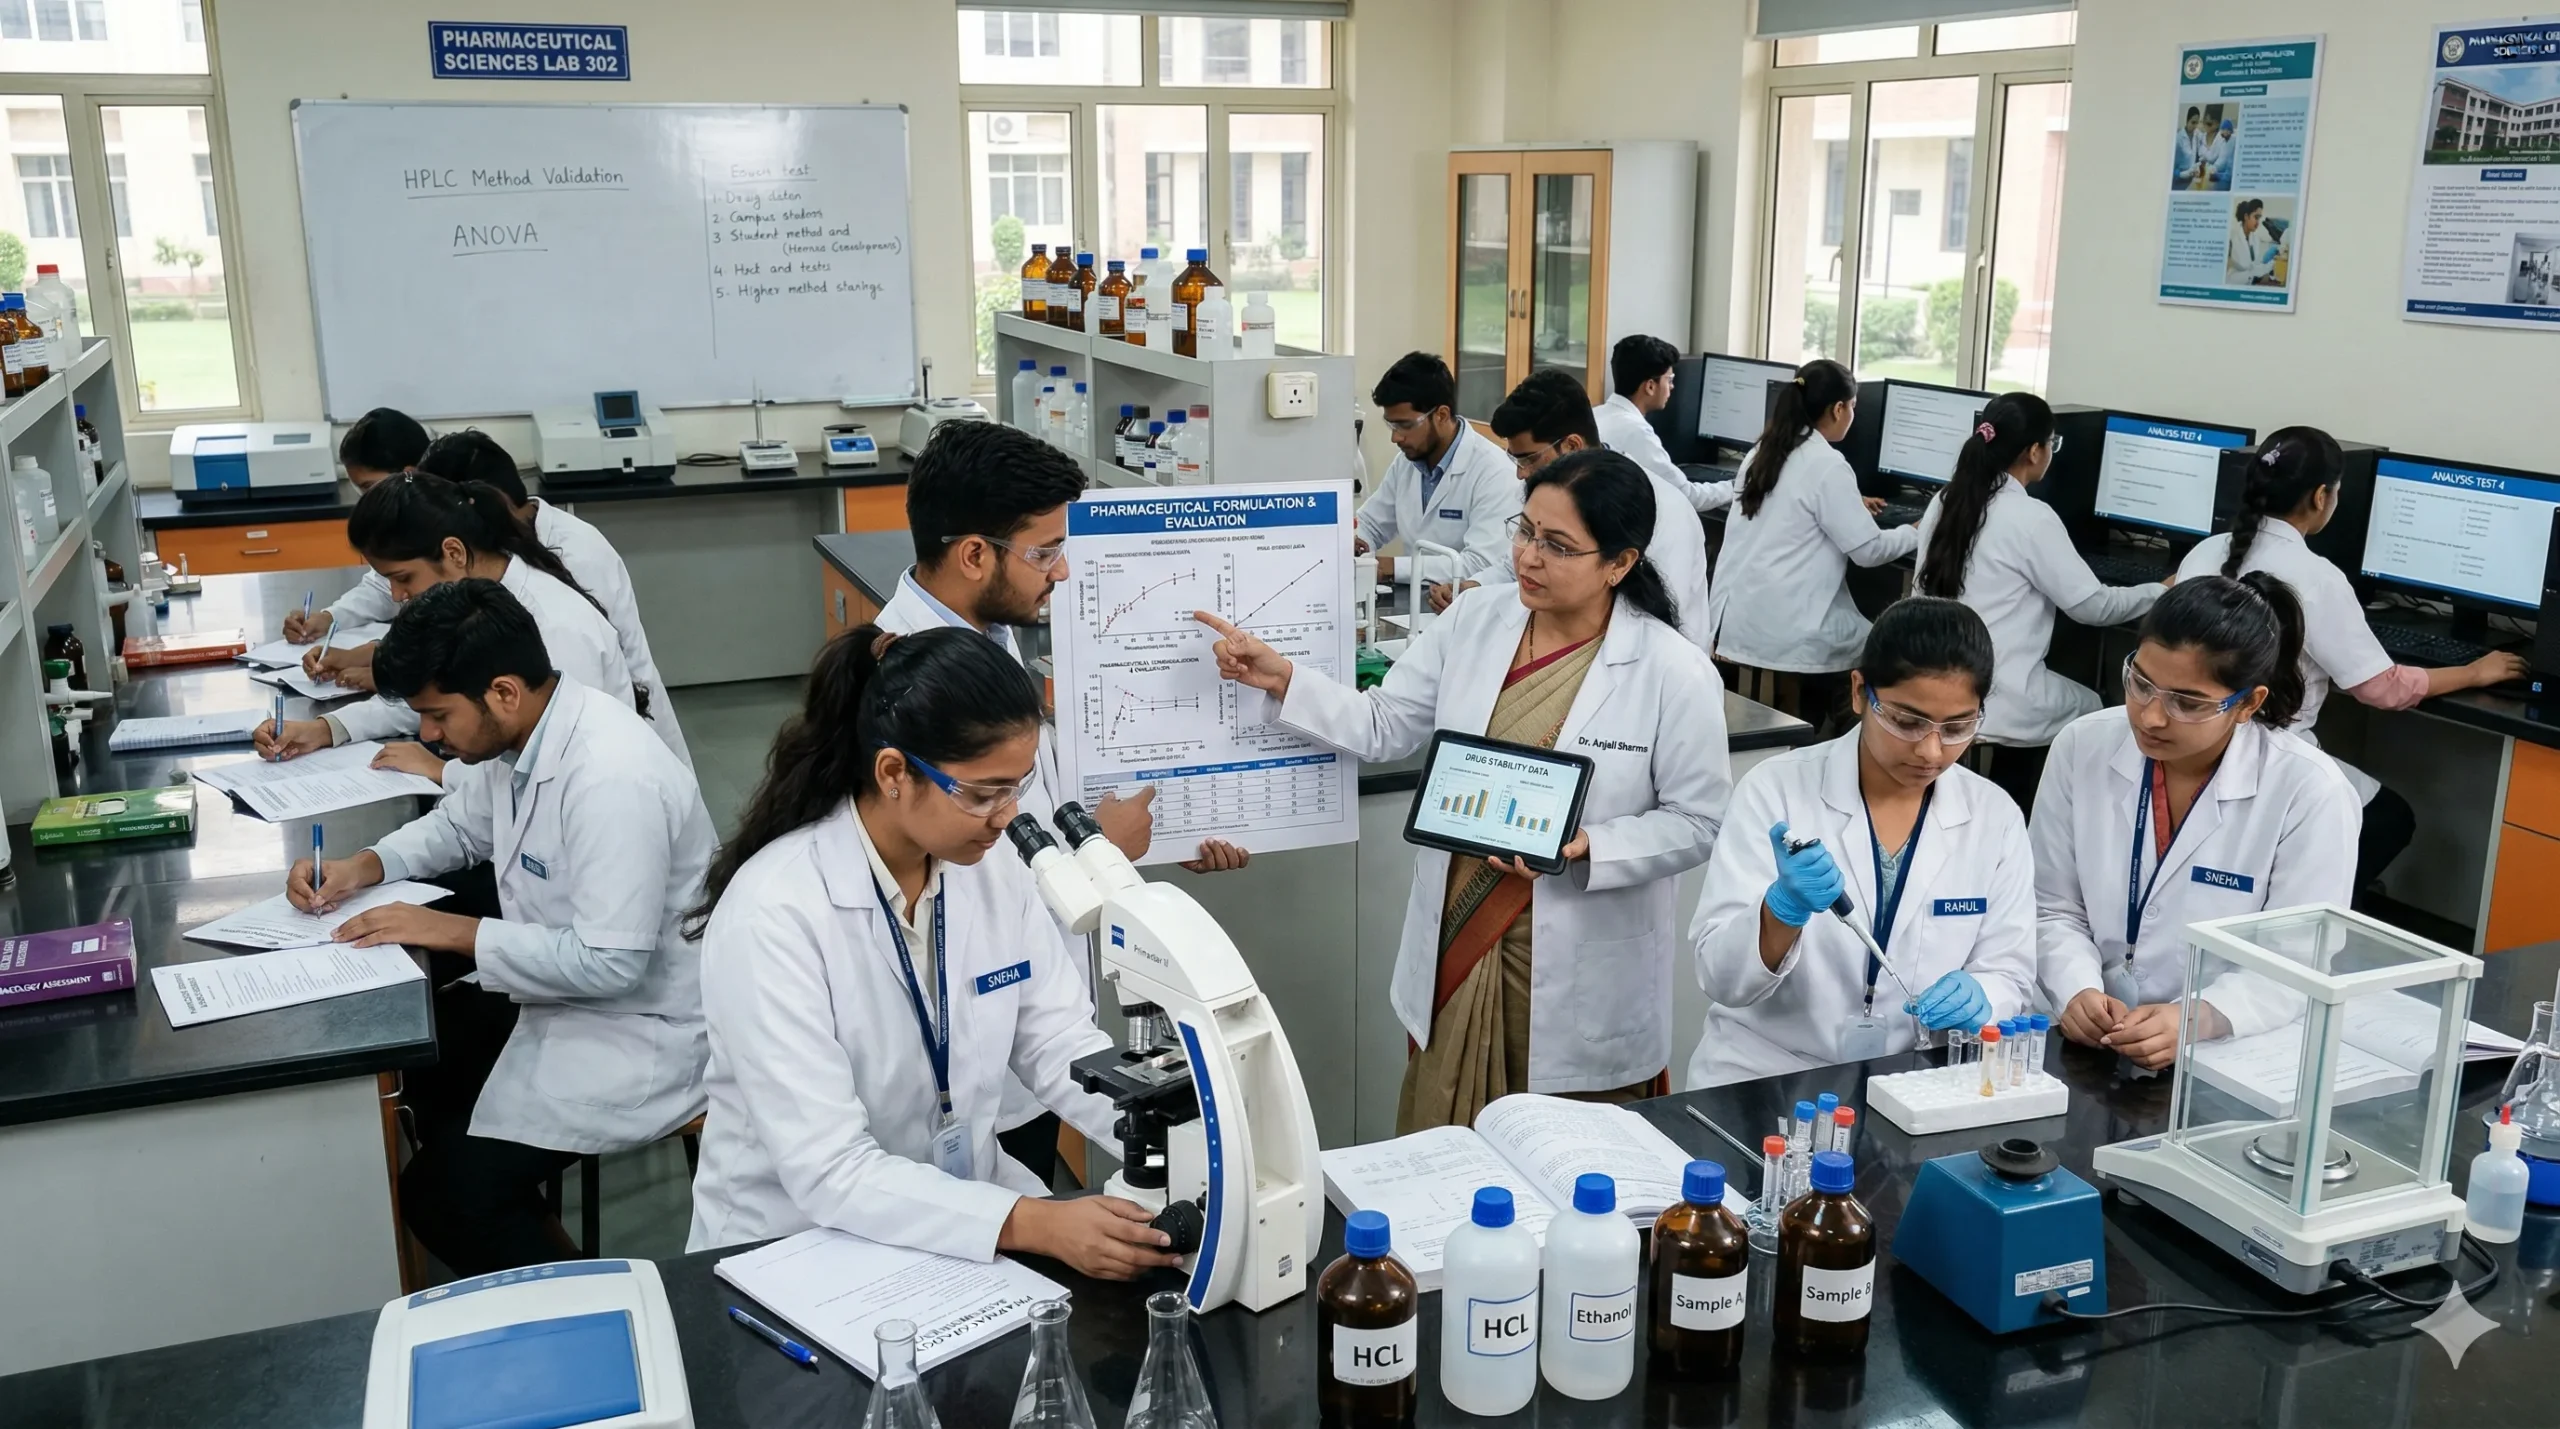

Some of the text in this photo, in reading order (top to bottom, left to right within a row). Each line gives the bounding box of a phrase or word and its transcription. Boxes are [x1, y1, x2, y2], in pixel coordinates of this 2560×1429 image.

[442, 30, 617, 50] PHARMACEUTICAL
[444, 53, 618, 72] SCIENCES LAB 302
[404, 167, 624, 189] HPLC Method Validation
[730, 210, 775, 226] Campus
[453, 222, 538, 247] ANOVA
[829, 223, 850, 236] and
[770, 261, 792, 273] and
[738, 285, 780, 303] Higher
[2476, 477, 2497, 489] TEST
[2499, 481, 2505, 490] 4
[1090, 496, 1316, 517] PHARMACEUTICAL FORMULATION &
[1165, 514, 1246, 529] EVALUATION
[1578, 736, 1590, 746] Dr.
[1465, 753, 1549, 777] DRUG STABILITY DATA
[2205, 871, 2239, 888] SNEHA
[1945, 901, 1979, 912] RAHUL
[988, 967, 1020, 987] SNEHA
[1676, 1291, 1743, 1313] Sample A
[1806, 1281, 1871, 1305] Sample B
[1577, 1303, 1631, 1324] Ethanol
[1484, 1313, 1529, 1338] HCL
[1354, 1343, 1404, 1368] HCL
